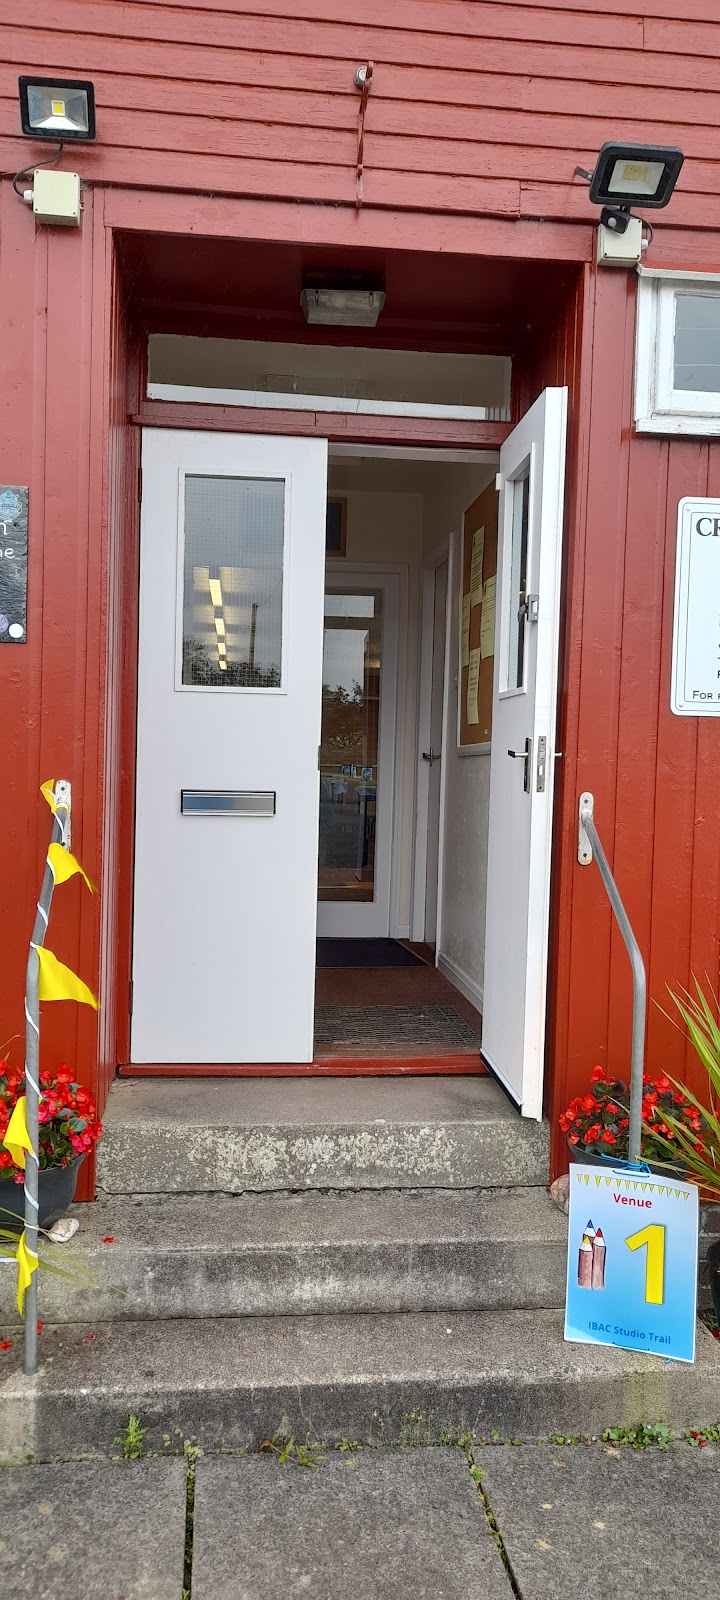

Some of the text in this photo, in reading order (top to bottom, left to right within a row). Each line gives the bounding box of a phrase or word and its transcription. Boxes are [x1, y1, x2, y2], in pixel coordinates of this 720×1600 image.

[0, 547, 16, 559] e
[613, 1193, 653, 1209] Venue
[624, 1223, 667, 1306] 1
[588, 1321, 671, 1345] IBAC Studio Trail
